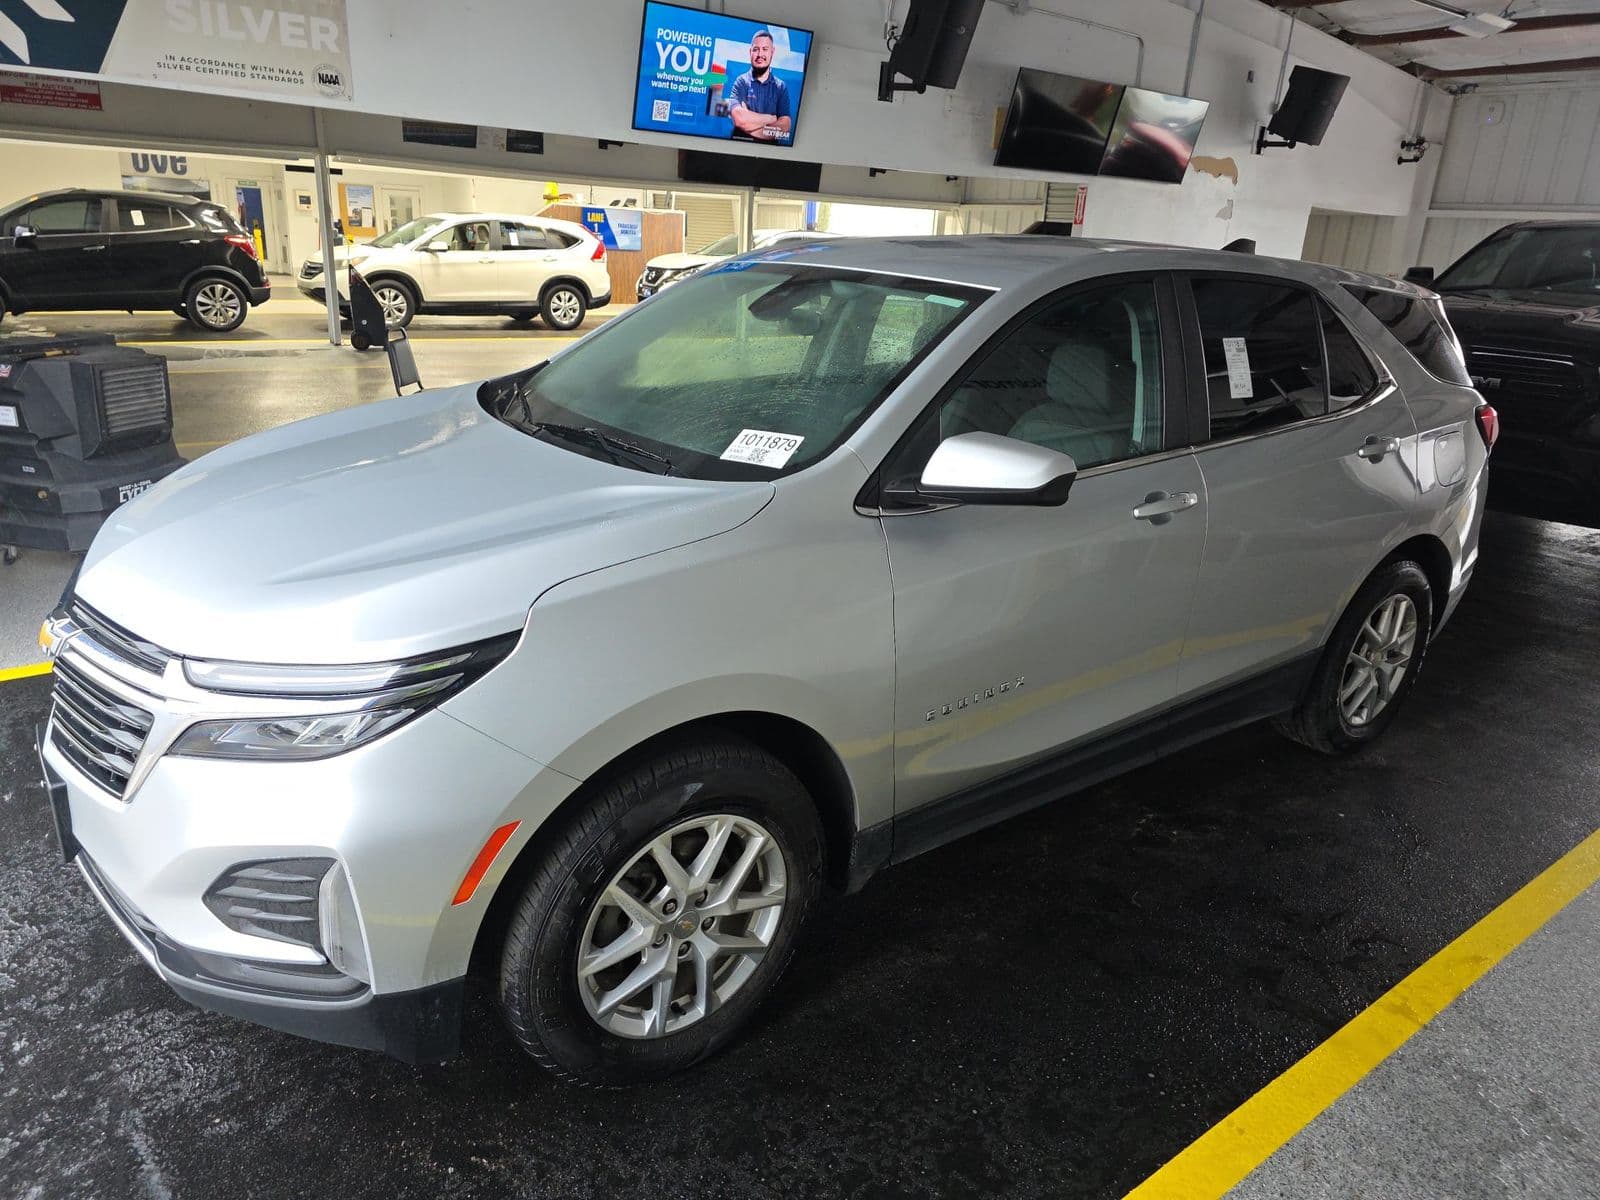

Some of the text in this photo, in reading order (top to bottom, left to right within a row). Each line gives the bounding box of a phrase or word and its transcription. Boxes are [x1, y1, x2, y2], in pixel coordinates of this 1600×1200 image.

[165, 0, 340, 53] SILVER
[657, 28, 712, 47] POWERING
[180, 56, 246, 70] ACCORDANCE
[250, 64, 275, 73] WITH
[278, 67, 304, 77] NAAA
[656, 41, 711, 75] YOU
[157, 61, 305, 85] SILVER CERTIFIED STANDARDS
[318, 72, 340, 86] NAAA
[656, 71, 704, 86] wherever you
[651, 80, 707, 95] want to go next!
[739, 433, 798, 452] 1011879
[926, 676, 1025, 721] EQUINOX
